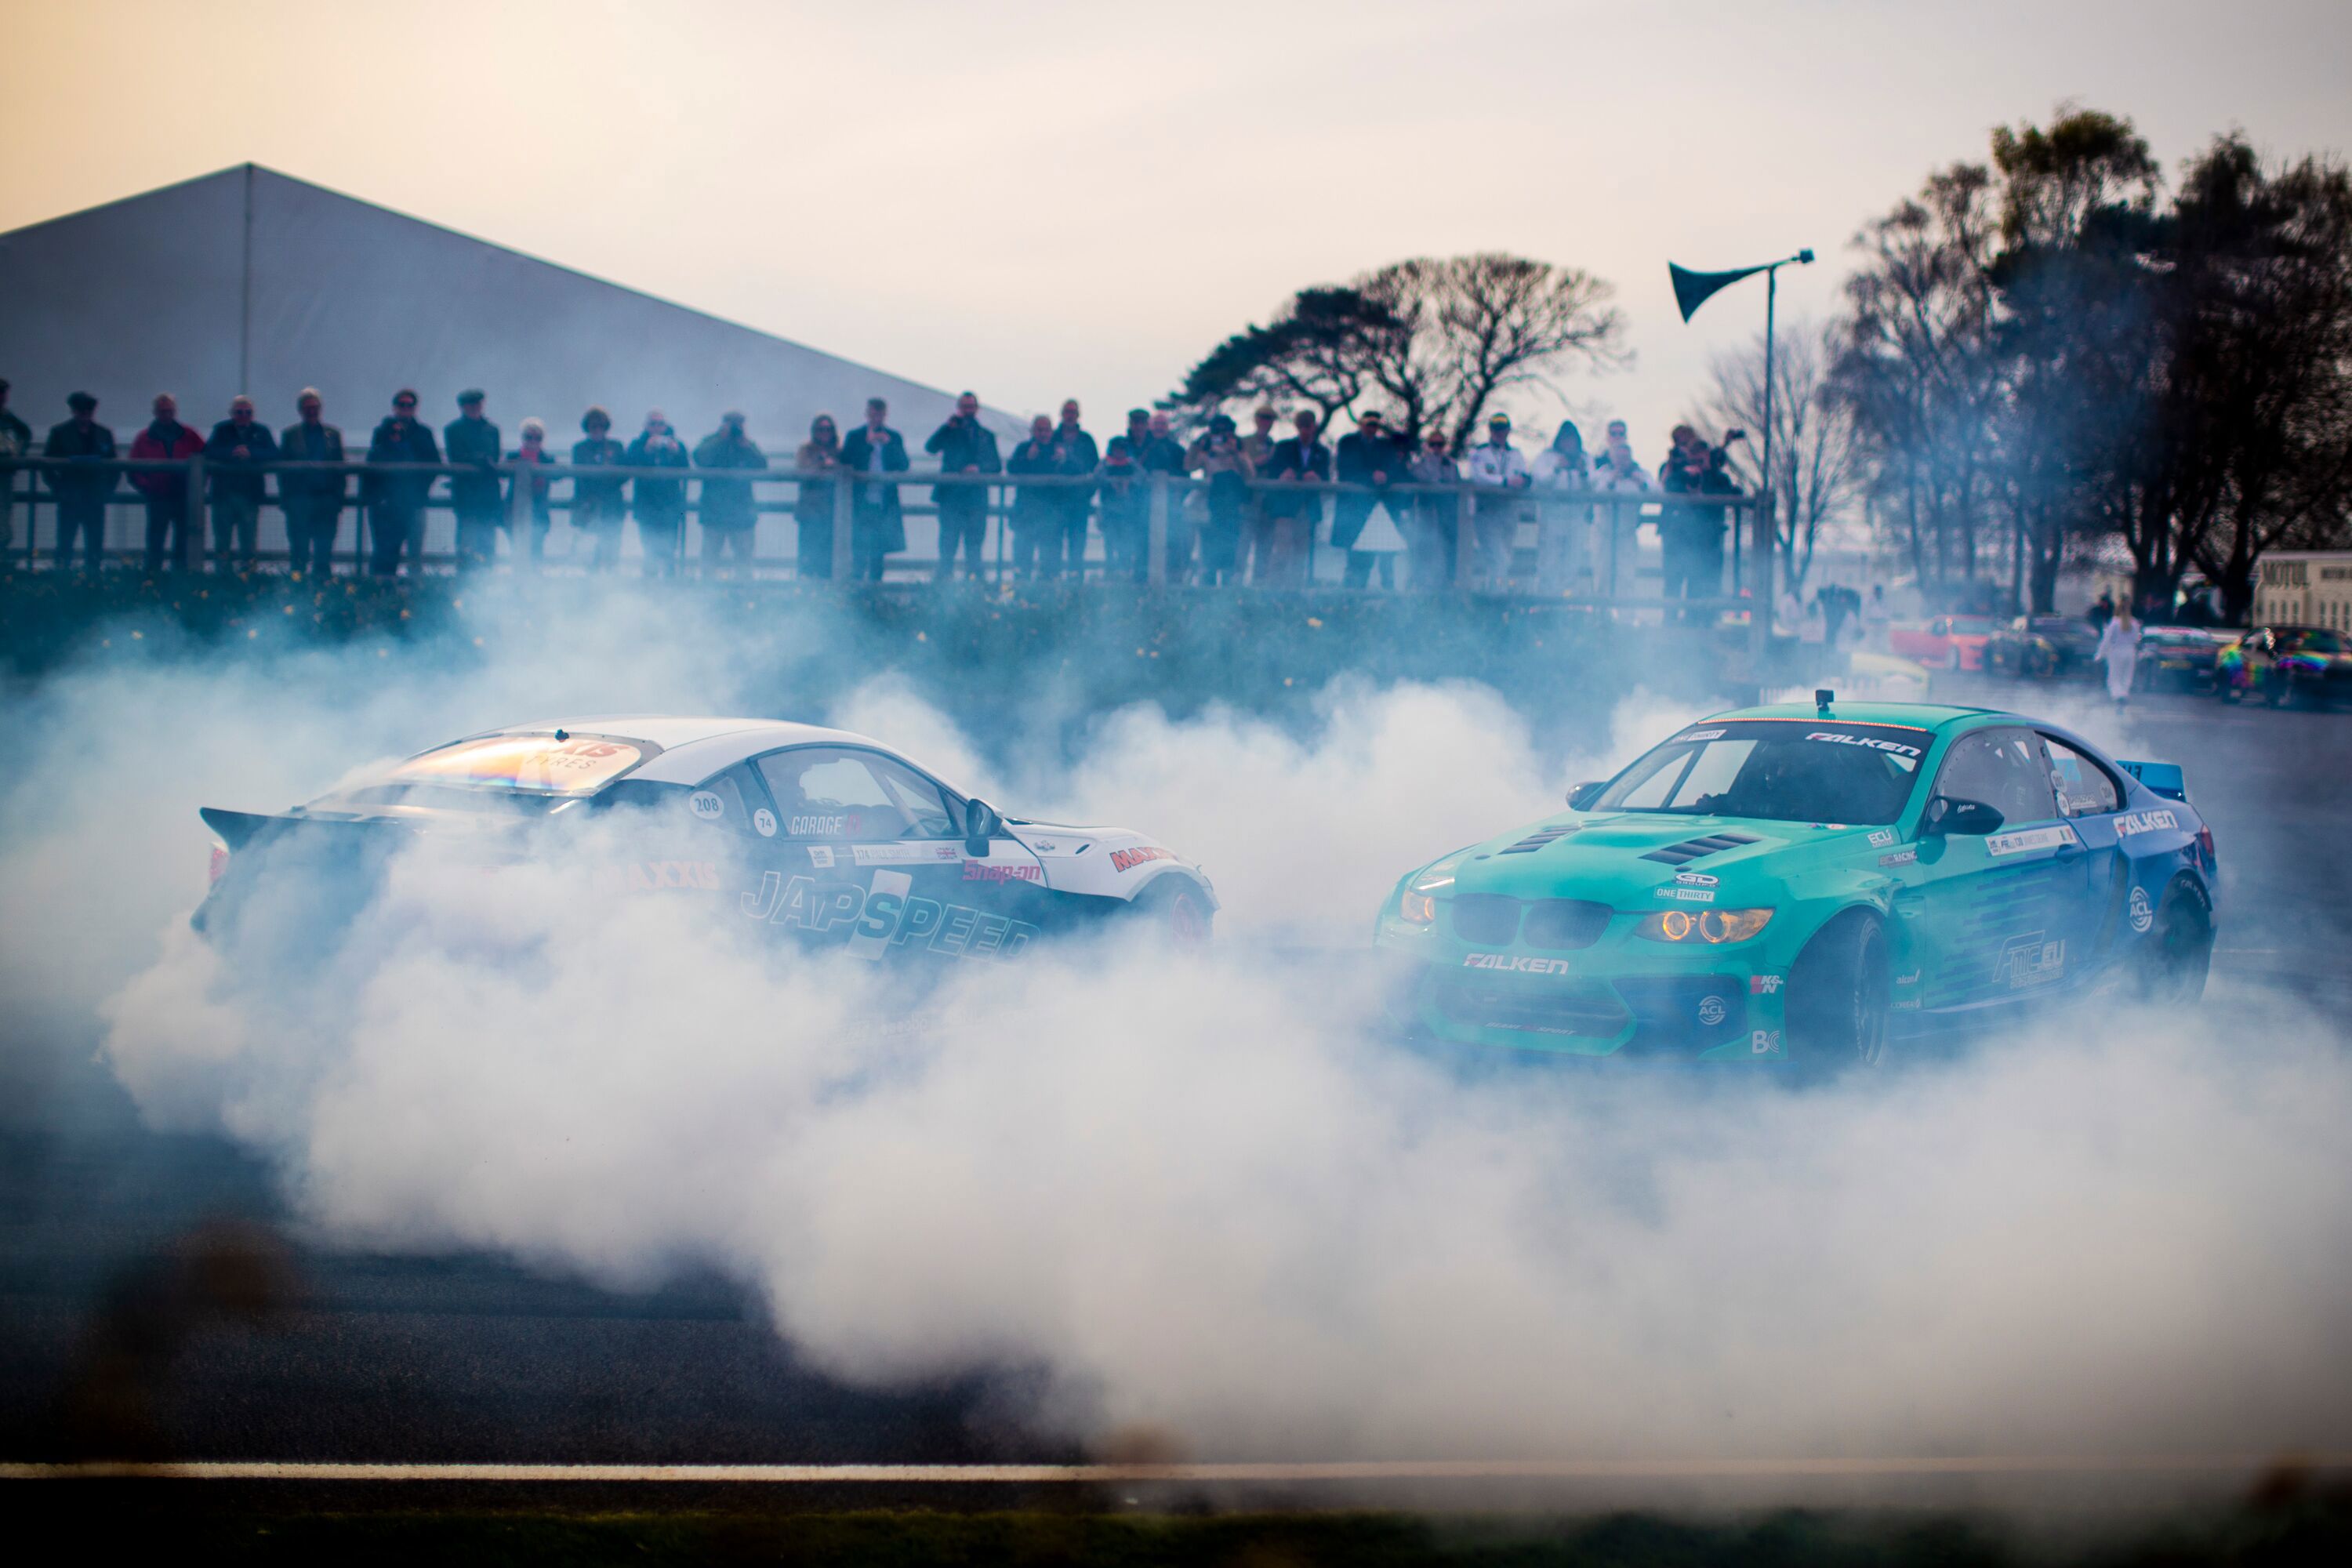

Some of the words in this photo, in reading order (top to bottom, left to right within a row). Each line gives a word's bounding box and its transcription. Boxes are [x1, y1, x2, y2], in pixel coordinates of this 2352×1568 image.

[1805, 731, 1922, 757] FALKEN
[526, 755, 597, 770] TYRES
[695, 797, 720, 812] 208
[790, 815, 843, 836] GARAGE
[2113, 810, 2179, 838] FALKEN
[1867, 828, 1892, 844] ECU
[962, 859, 1041, 885] Snap-on
[1657, 887, 1677, 898] ONE
[1679, 890, 1712, 900] THIRTY
[740, 870, 1041, 965] JAPSPEED
[2129, 901, 2152, 917] ACL
[1463, 953, 1569, 975] FALKEN
[1698, 1005, 1726, 1016] ACL
